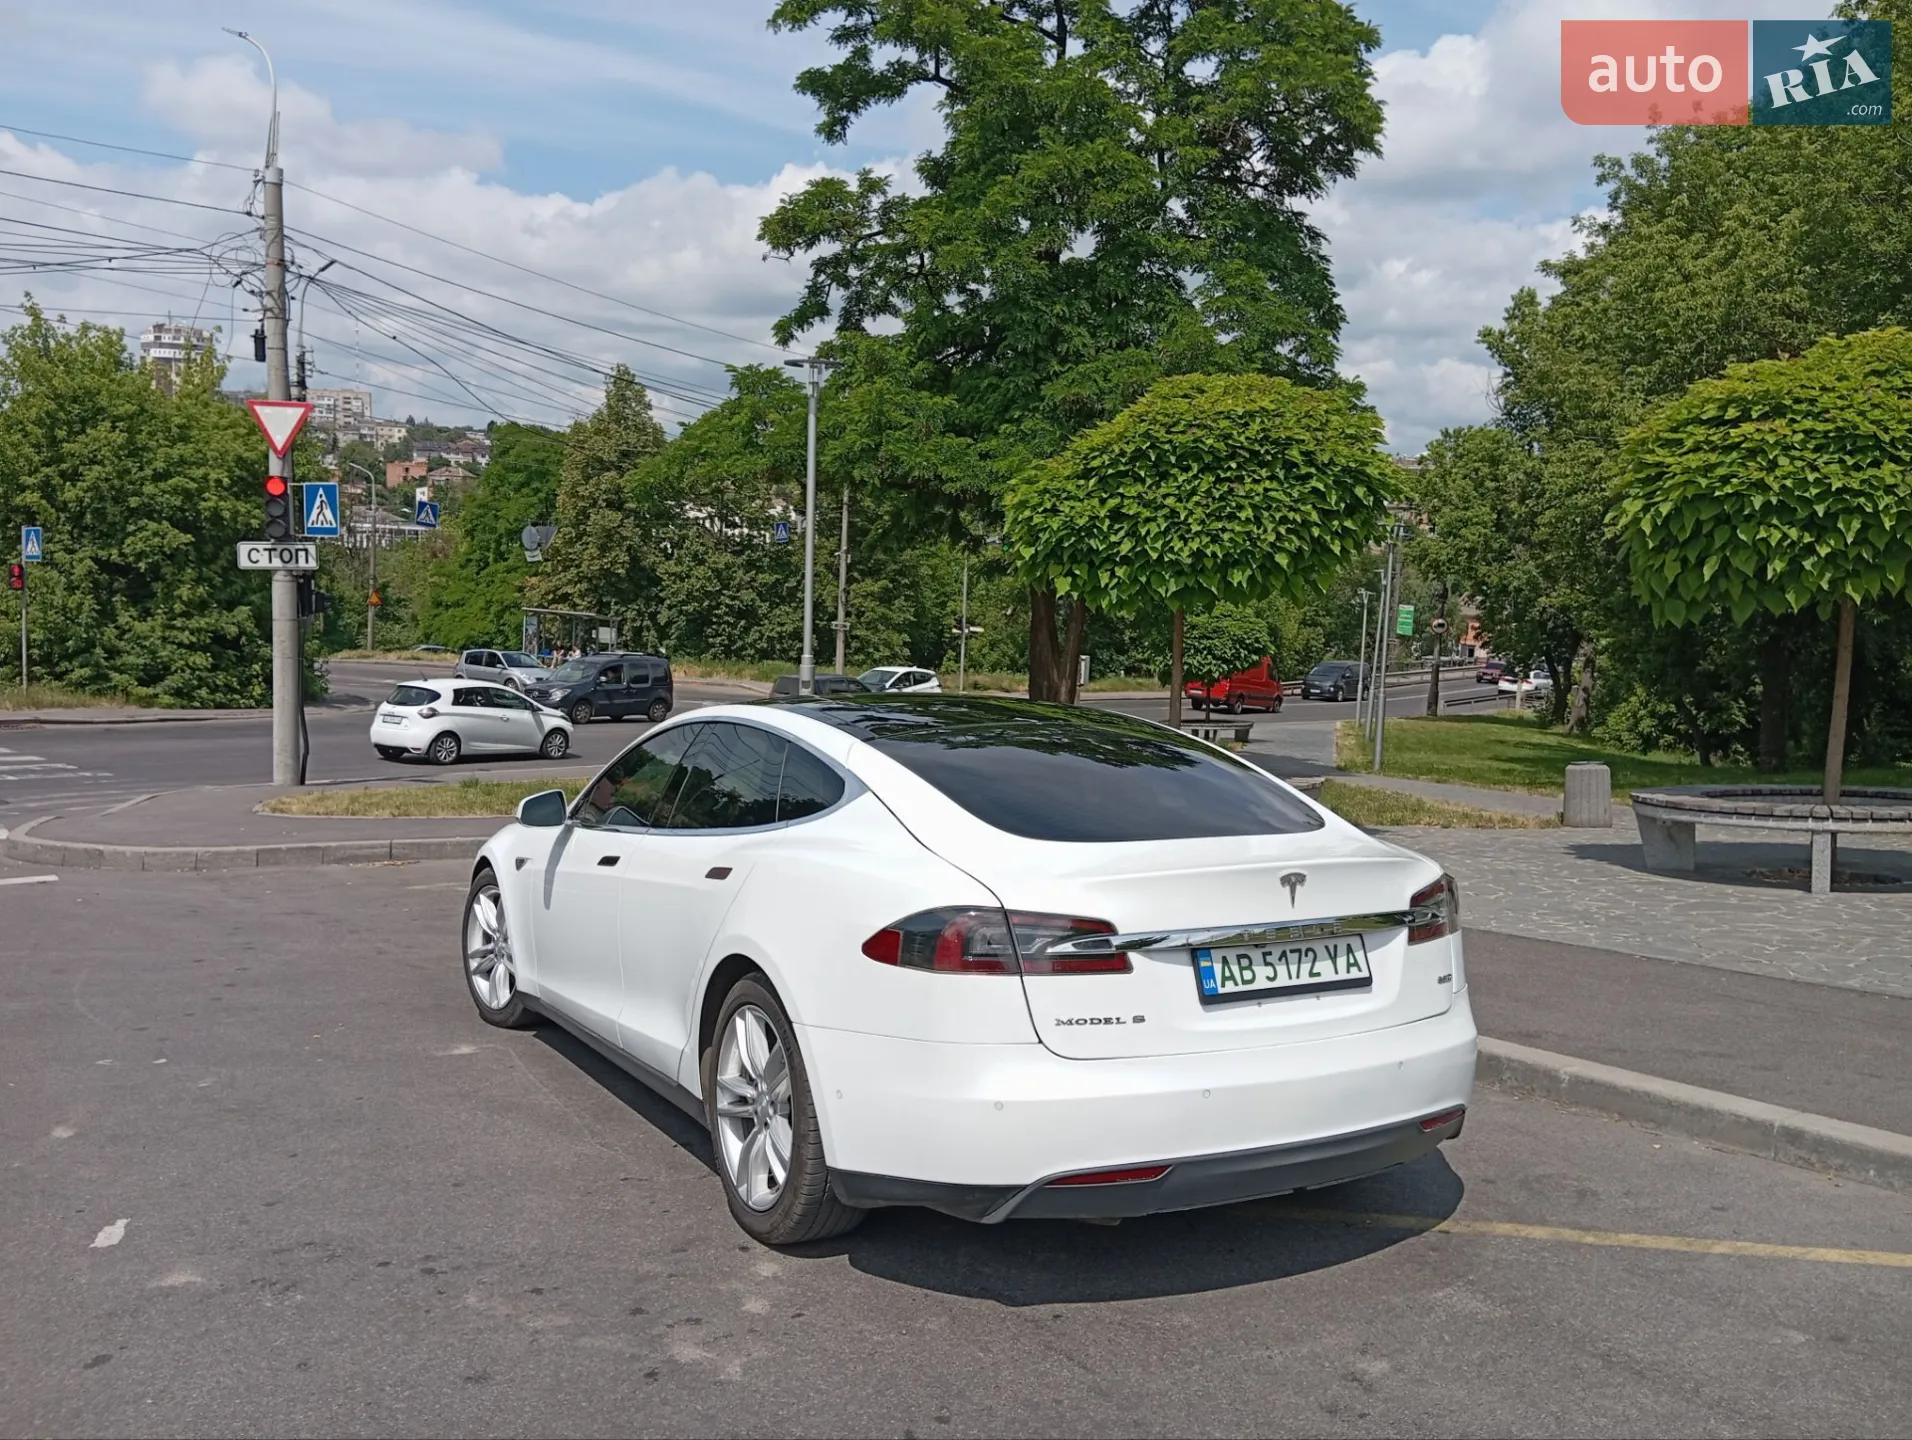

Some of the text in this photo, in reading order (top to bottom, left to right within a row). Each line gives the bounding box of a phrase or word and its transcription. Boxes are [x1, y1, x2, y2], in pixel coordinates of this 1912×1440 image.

[247, 548, 309, 564] СТОП
[1221, 943, 1363, 988] AB 5172 YA
[1203, 979, 1217, 989] UA
[1055, 1015, 1146, 1026] MODEL S
